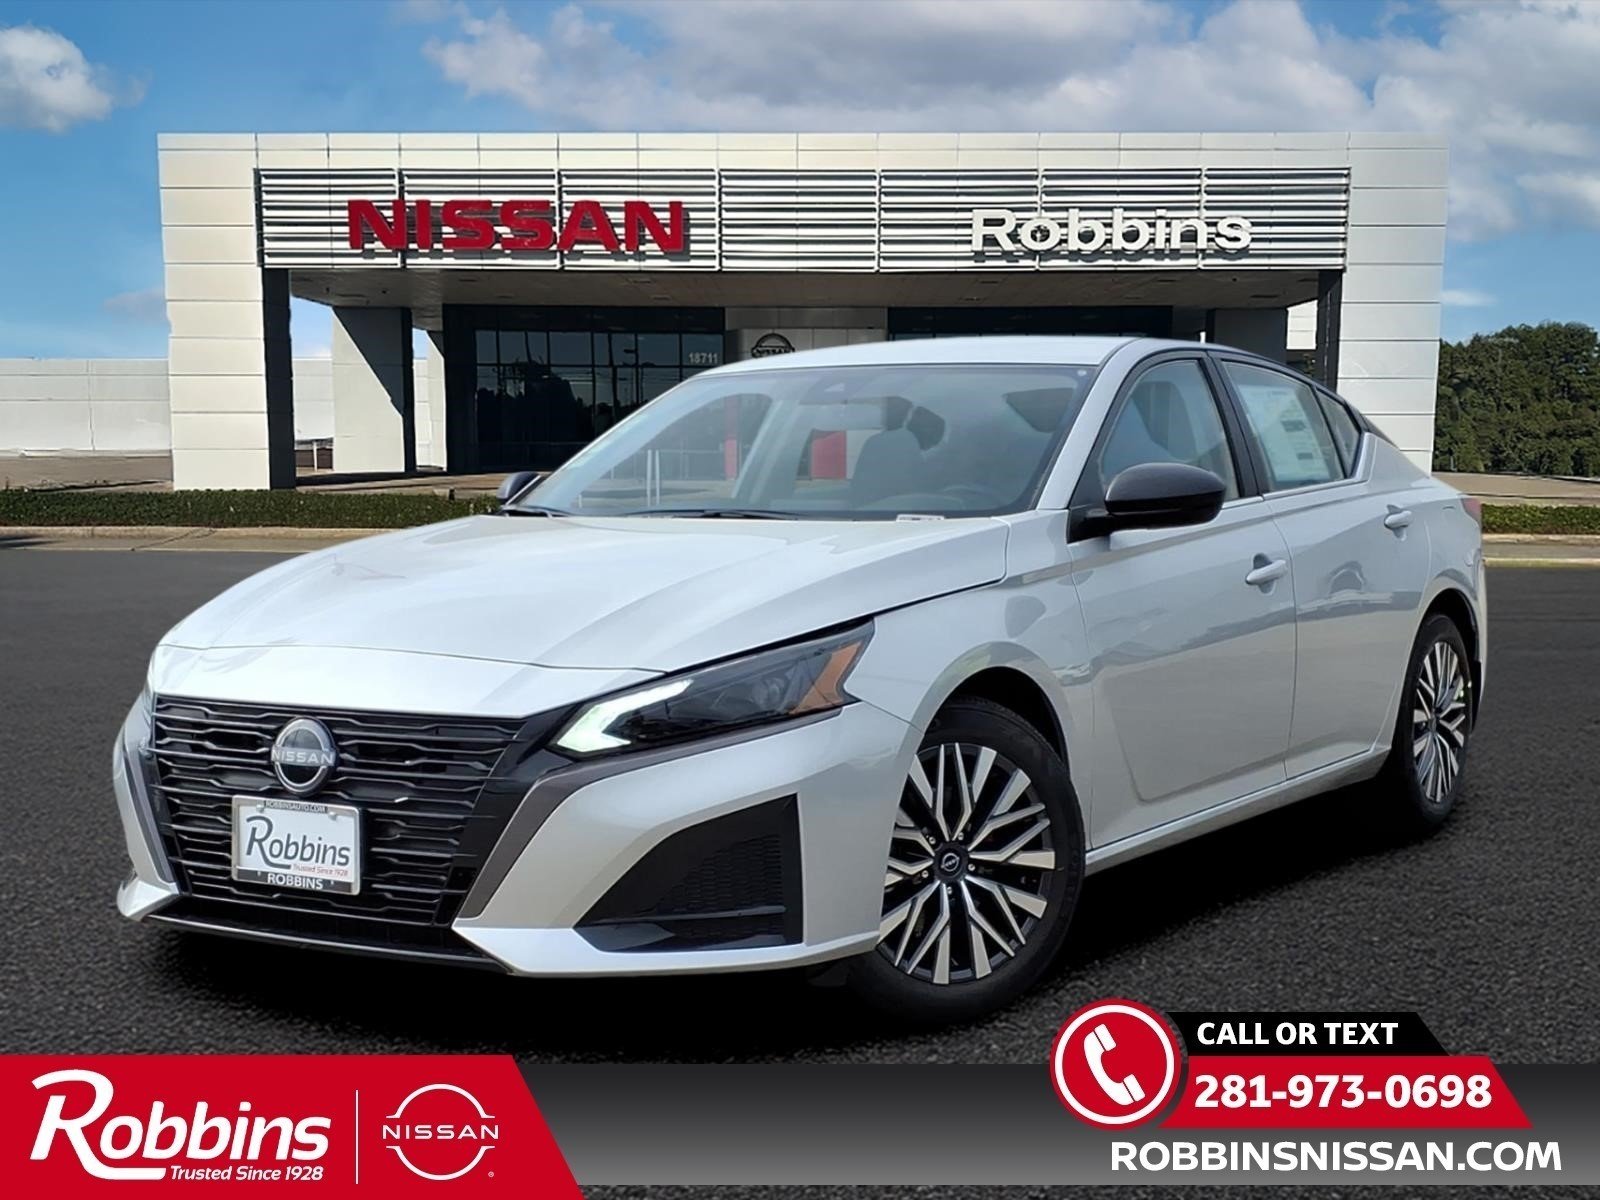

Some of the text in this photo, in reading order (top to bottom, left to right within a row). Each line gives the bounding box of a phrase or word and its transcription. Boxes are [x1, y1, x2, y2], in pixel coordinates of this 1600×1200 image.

[347, 199, 684, 252] NISSAN
[971, 208, 1252, 252] Robbins
[688, 352, 718, 364] 18711
[271, 748, 334, 764] NISSAN
[246, 815, 350, 870] Robbins
[267, 873, 324, 890] ROBBINS
